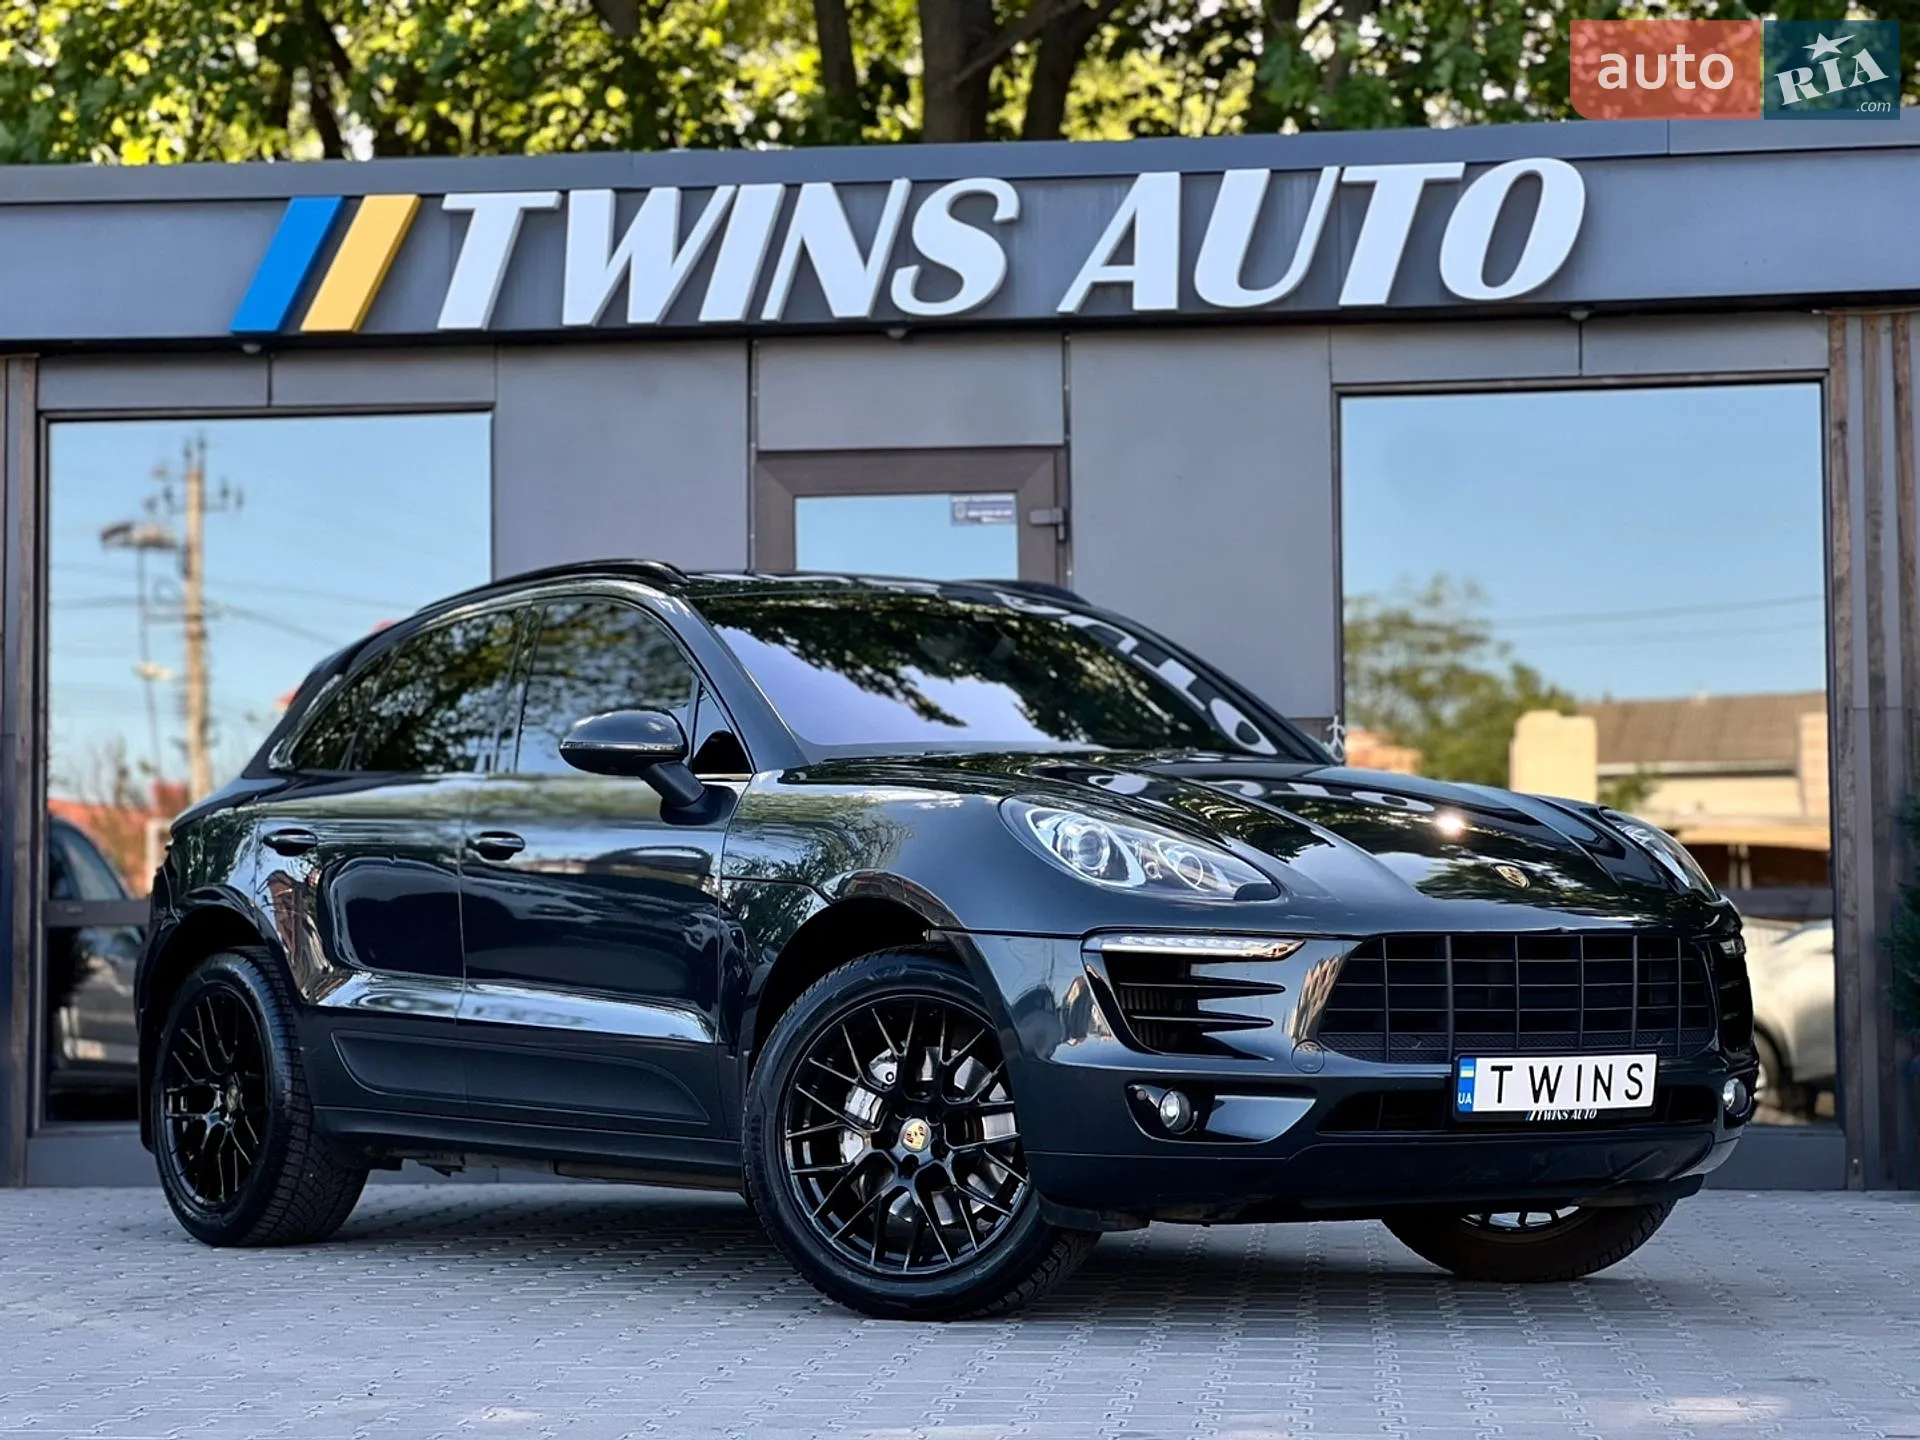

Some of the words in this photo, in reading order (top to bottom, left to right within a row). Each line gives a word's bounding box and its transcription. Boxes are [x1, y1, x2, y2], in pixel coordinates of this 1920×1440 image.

[436, 177, 1021, 332] TWINS
[1056, 157, 1587, 314] AUTO
[1457, 1091, 1473, 1105] UA
[1490, 1062, 1644, 1104] TWINS
